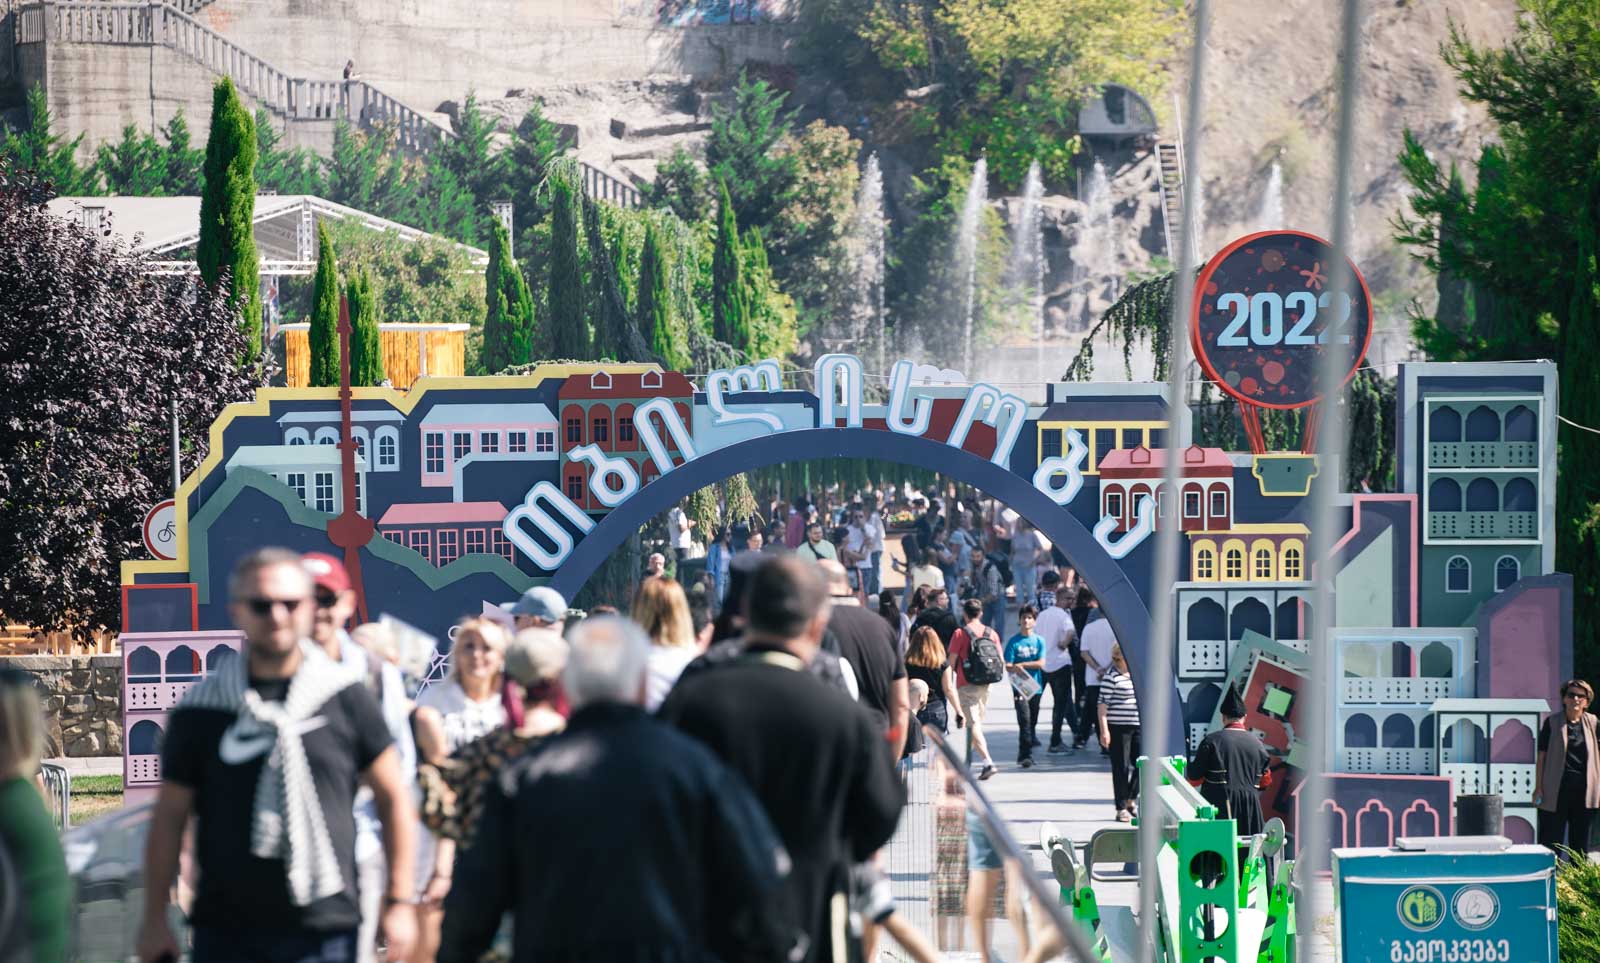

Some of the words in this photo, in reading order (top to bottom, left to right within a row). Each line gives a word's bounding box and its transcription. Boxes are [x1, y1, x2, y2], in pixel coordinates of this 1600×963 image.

[1216, 291, 1351, 347] 2022
[502, 353, 1158, 571] თბილისობა
[1390, 939, 1510, 963] გამოკვებე
